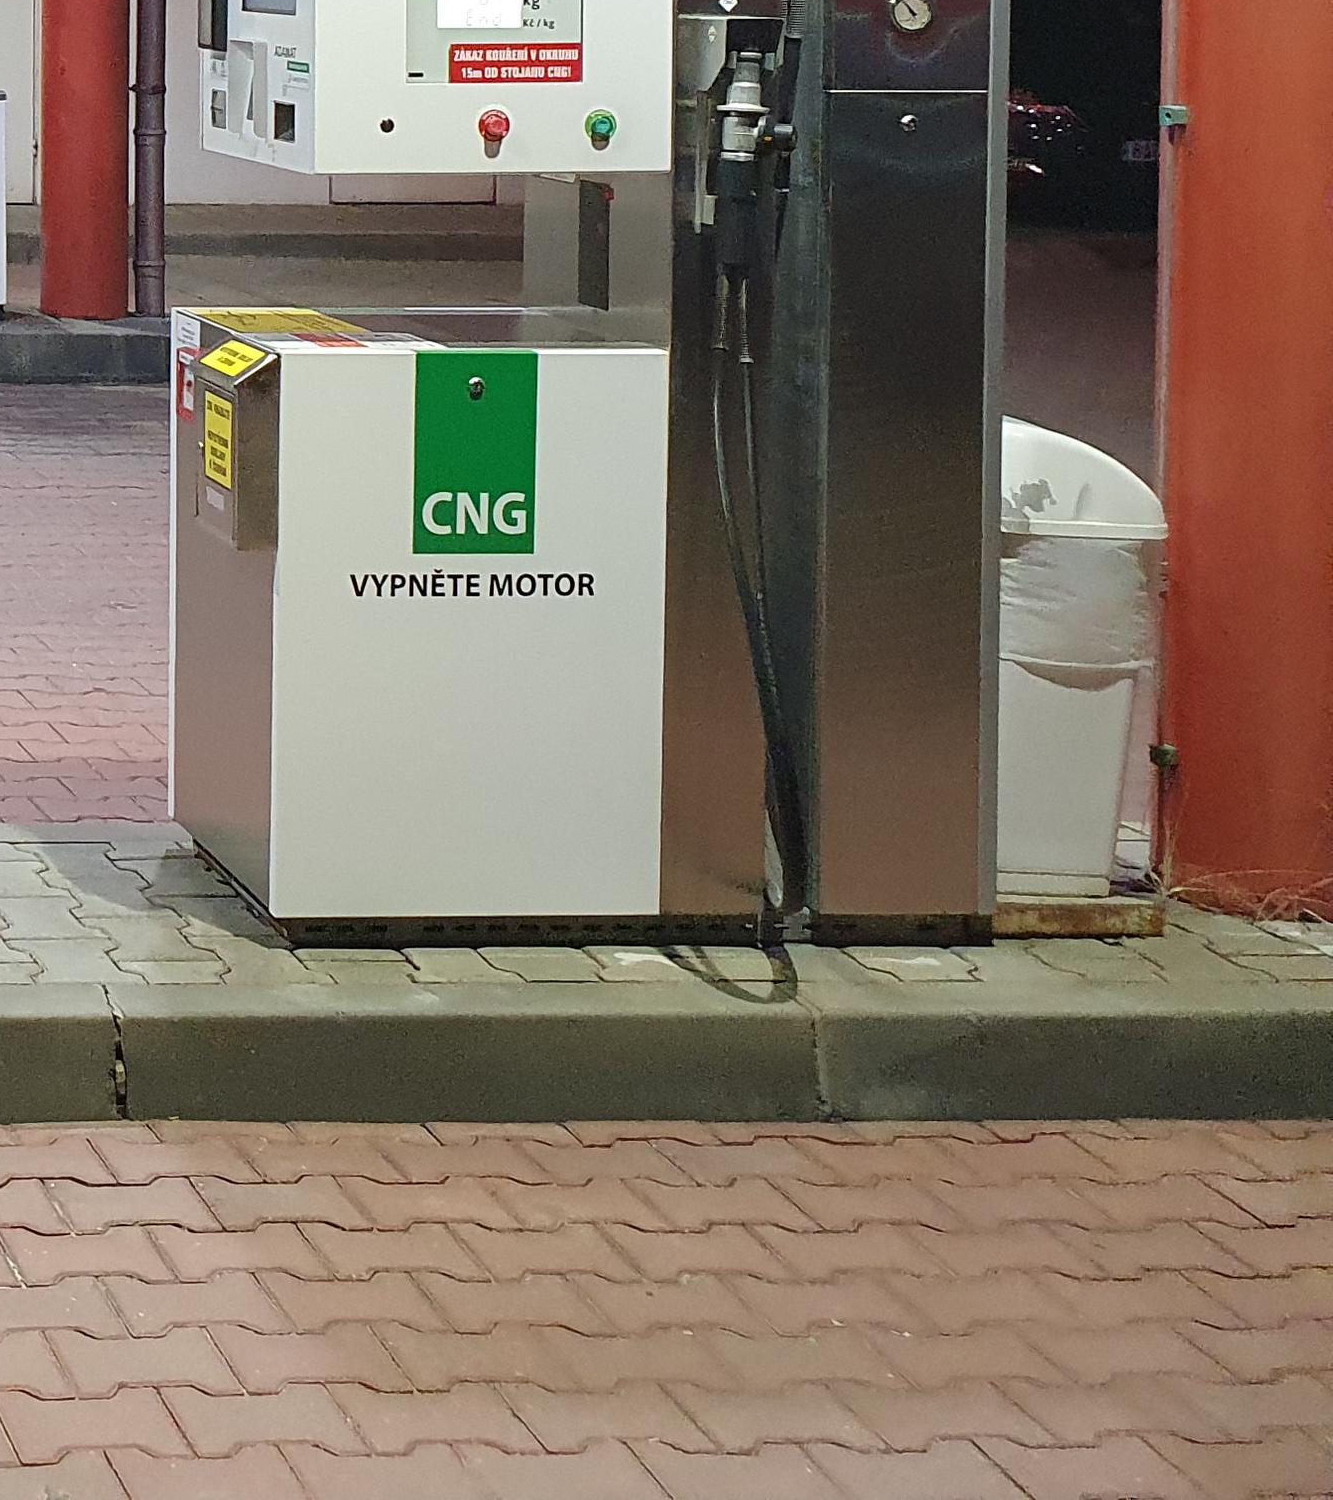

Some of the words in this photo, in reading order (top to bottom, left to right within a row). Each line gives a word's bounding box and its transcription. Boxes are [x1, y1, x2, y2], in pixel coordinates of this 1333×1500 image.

[454, 47, 484, 61] ZÁKAZ
[530, 49, 538, 61] V
[461, 67, 483, 79] 15m
[484, 67, 499, 79] OD
[422, 491, 527, 535] CNG
[350, 569, 481, 598] VYPNĚTE
[489, 573, 595, 597] MOTOR
